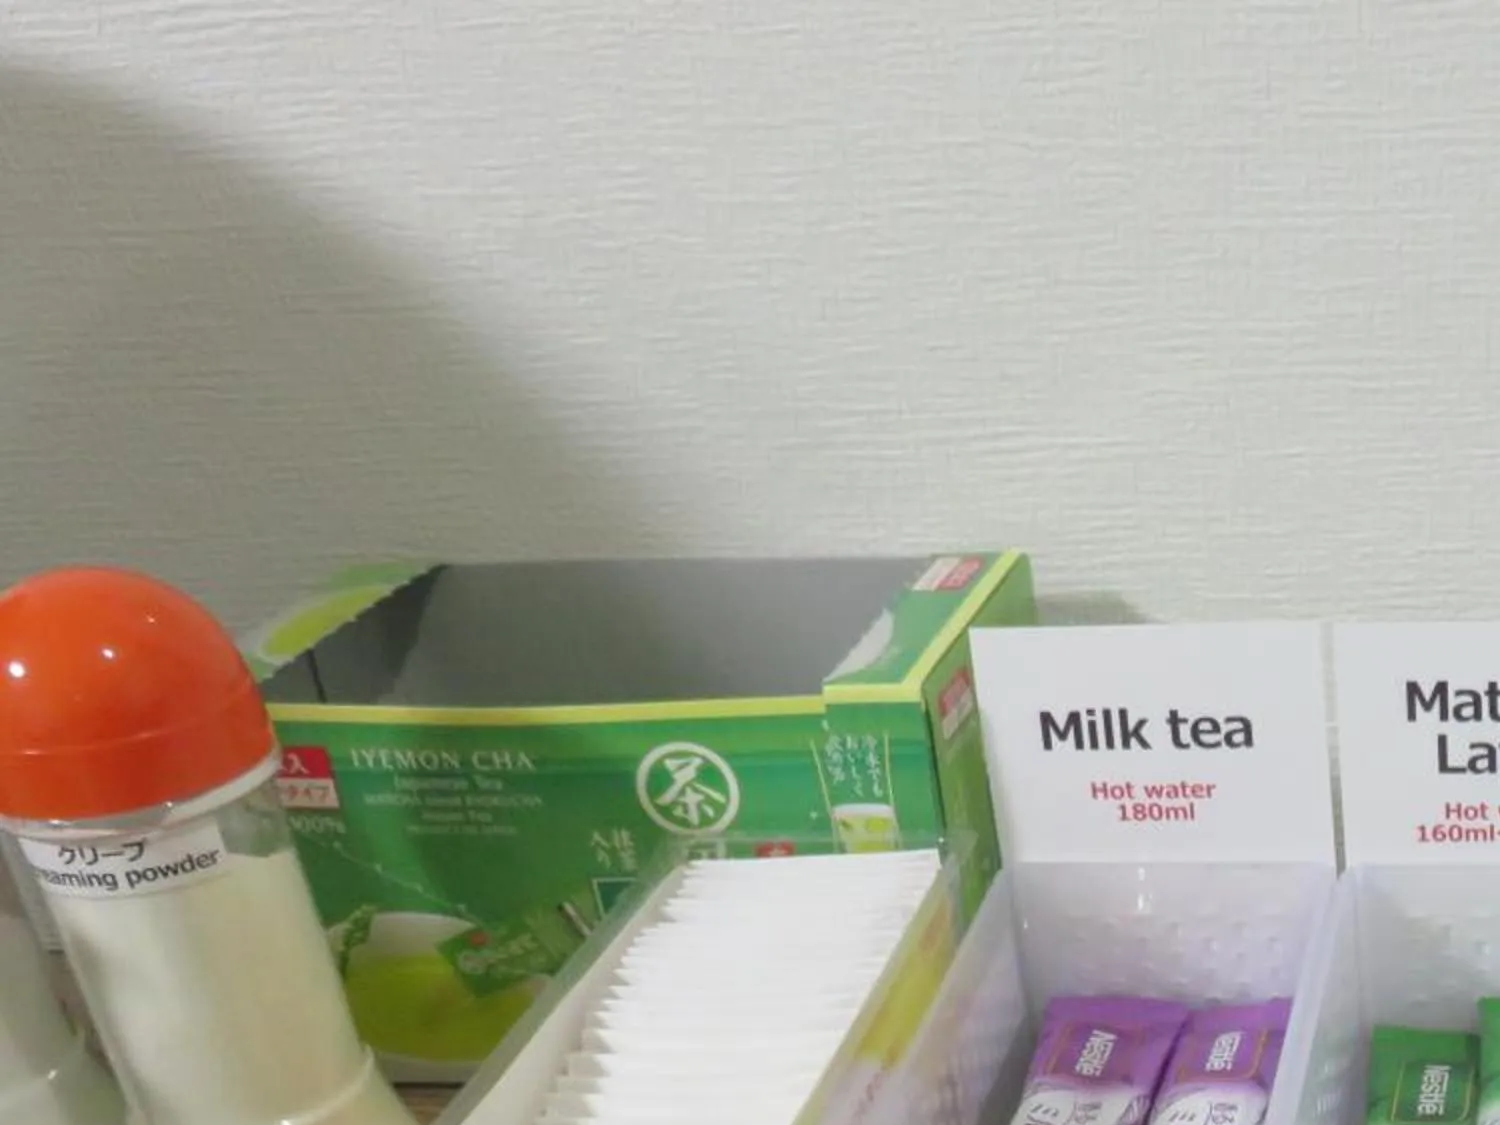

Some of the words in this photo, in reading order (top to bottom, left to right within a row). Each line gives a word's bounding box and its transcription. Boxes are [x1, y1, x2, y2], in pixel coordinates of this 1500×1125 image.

[1038, 707, 1152, 752] Milk
[1165, 709, 1254, 750] tea
[471, 750, 538, 771] CHA
[1090, 781, 1135, 801] Hot
[1143, 781, 1218, 800] water
[1117, 803, 1196, 822] 180ml
[1444, 802, 1489, 821] Hot
[125, 849, 220, 889] powder
